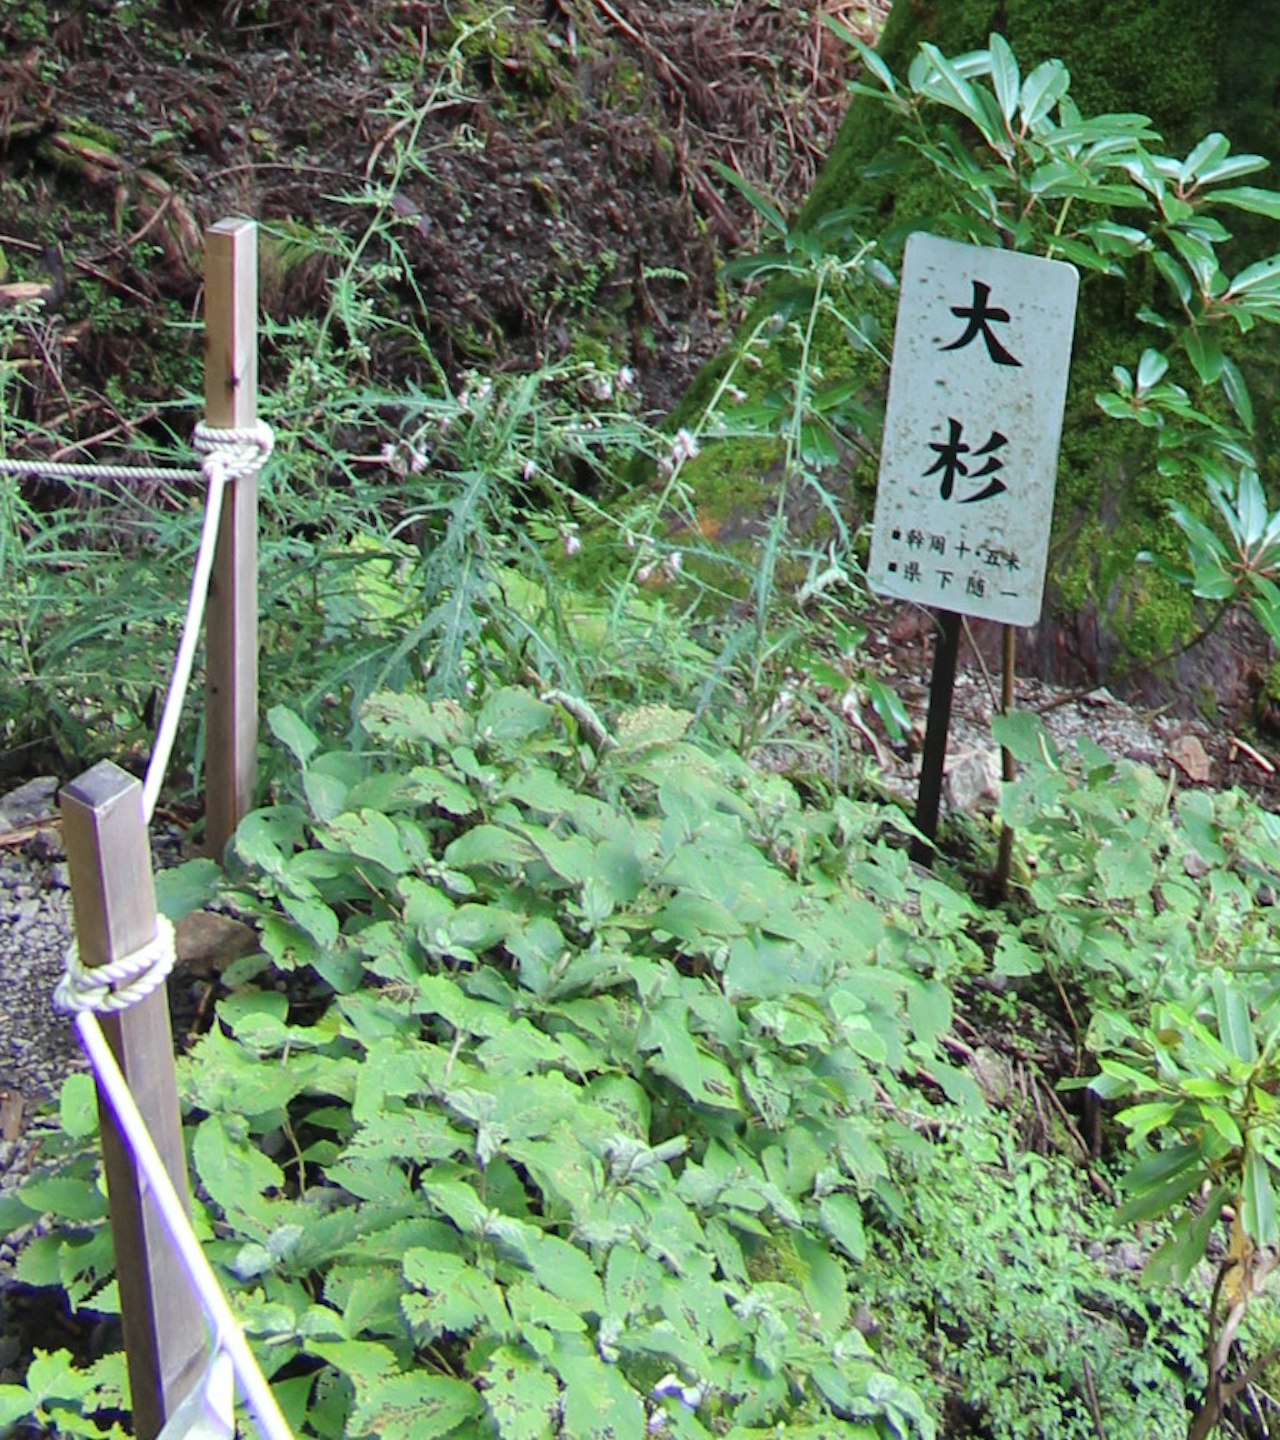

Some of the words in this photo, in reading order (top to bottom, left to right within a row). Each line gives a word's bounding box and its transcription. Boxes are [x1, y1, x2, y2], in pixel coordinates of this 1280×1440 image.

[920, 280, 1023, 504] 大杉
[904, 560, 1018, 598] 県下随一
